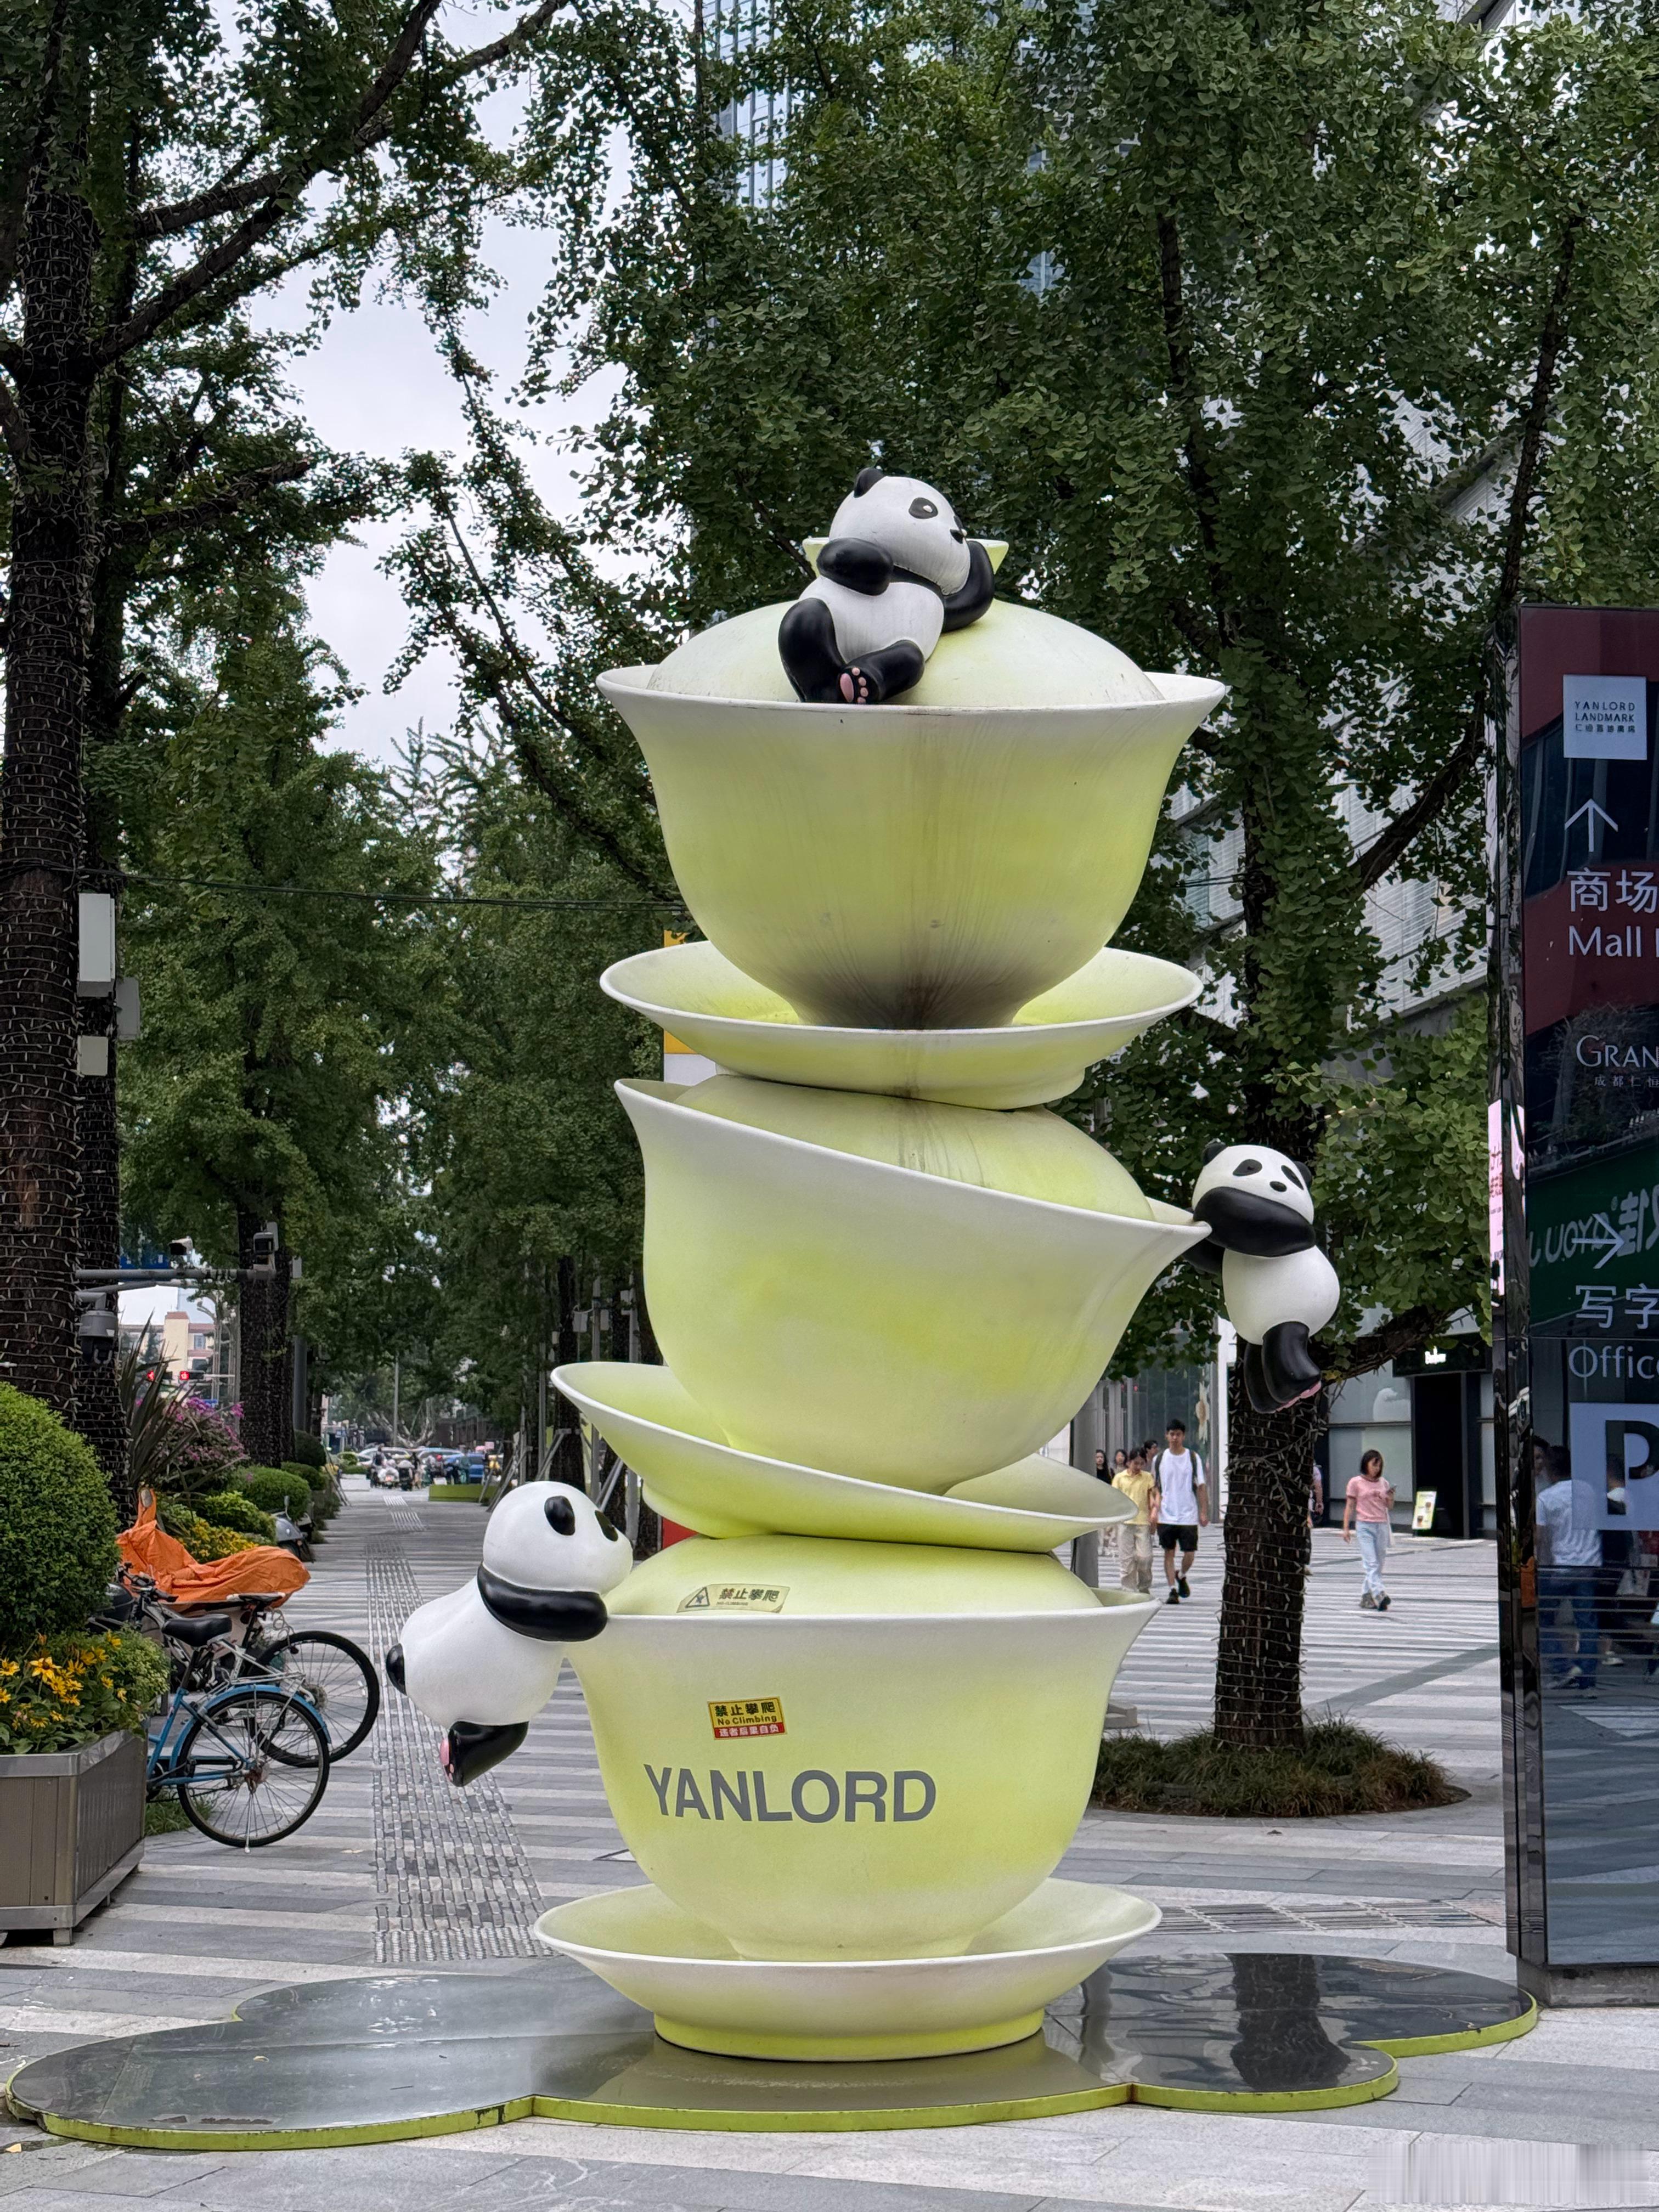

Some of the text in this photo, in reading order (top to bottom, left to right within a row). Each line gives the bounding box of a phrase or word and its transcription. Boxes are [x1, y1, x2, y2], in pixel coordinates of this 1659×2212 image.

[1575, 701, 1635, 712] YANLORD
[1575, 712, 1634, 723] LANDMARK
[1567, 867, 1658, 913] 商场
[1569, 926, 1642, 957] Mall
[1576, 1283, 1659, 1329] 写字
[1568, 1346, 1659, 1379] Offic
[1605, 1420, 1659, 1515] P
[719, 1588, 780, 1602] 禁止攀爬
[714, 1702, 775, 1717] 禁止攀爬
[732, 1716, 777, 1724] Climbing
[644, 1764, 936, 1823] YANLORD
